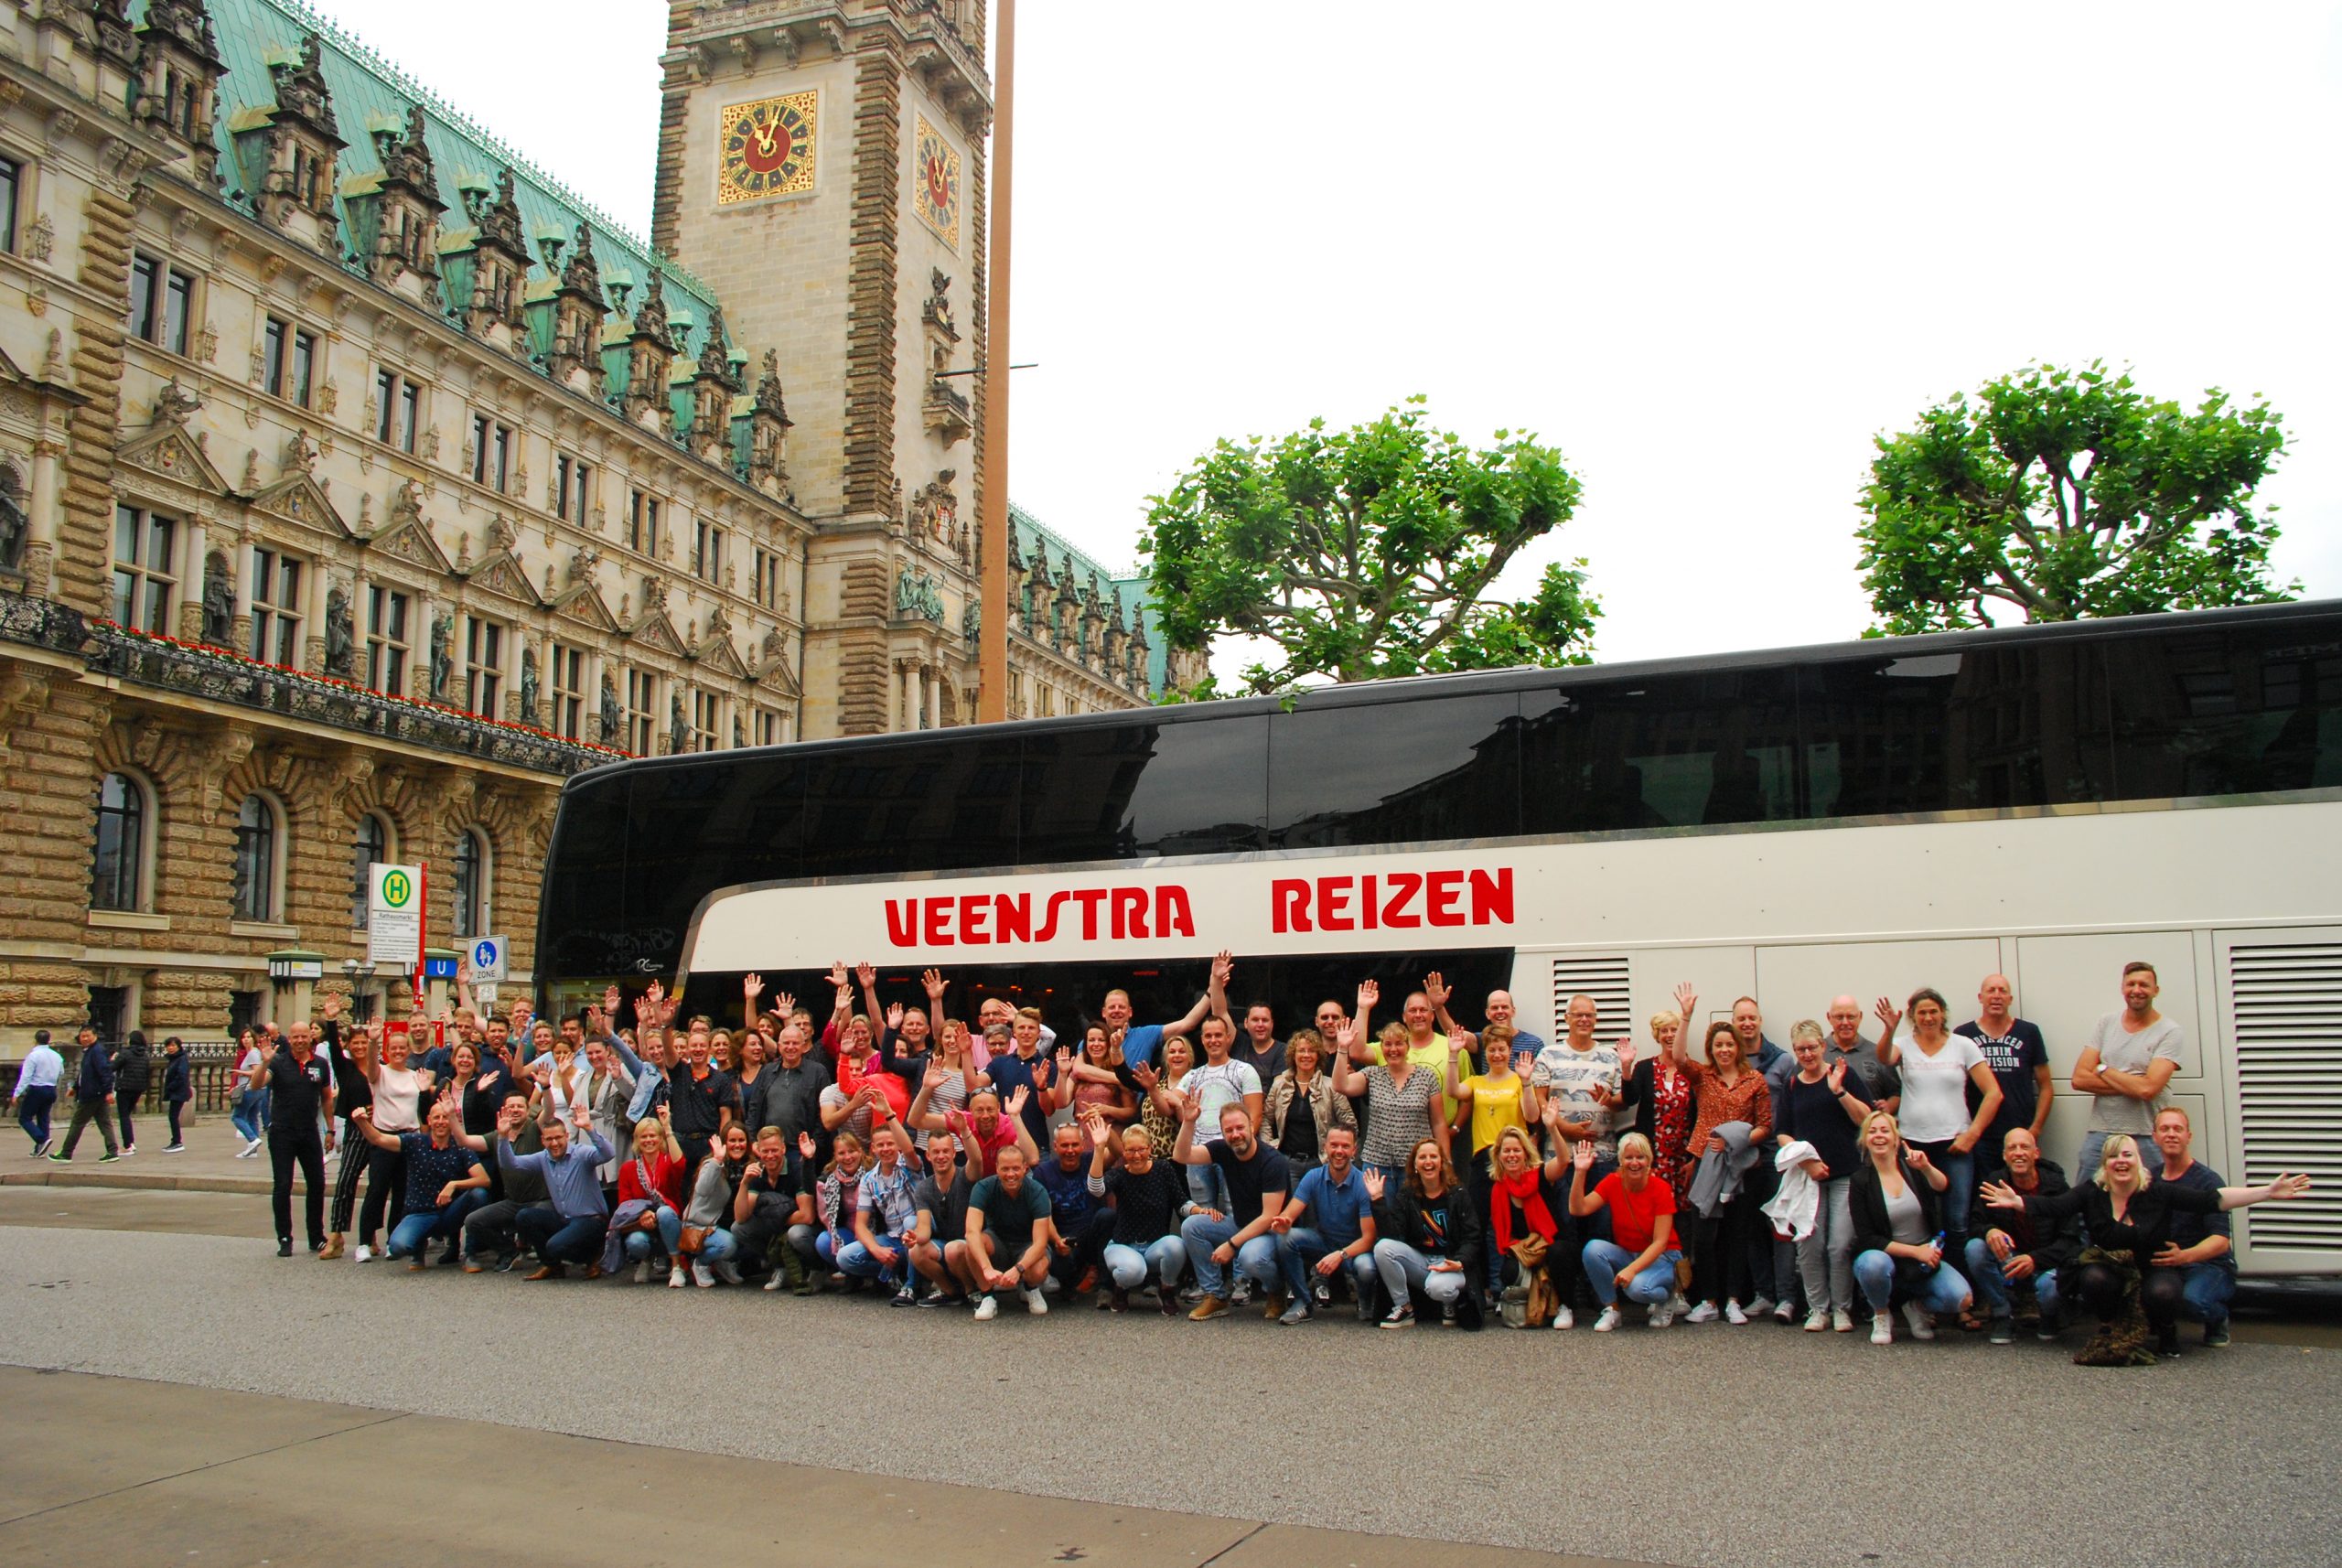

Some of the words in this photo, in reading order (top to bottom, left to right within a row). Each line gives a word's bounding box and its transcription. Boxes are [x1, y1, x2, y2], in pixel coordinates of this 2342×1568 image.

[390, 878, 403, 898] H
[886, 886, 1195, 947] VEENSTRA
[1273, 868, 1513, 933] REIZEN
[436, 961, 446, 975] U
[477, 970, 496, 979] ZONE
[1972, 1035, 2024, 1050] DVANCED
[1986, 1057, 2020, 1067] VISION
